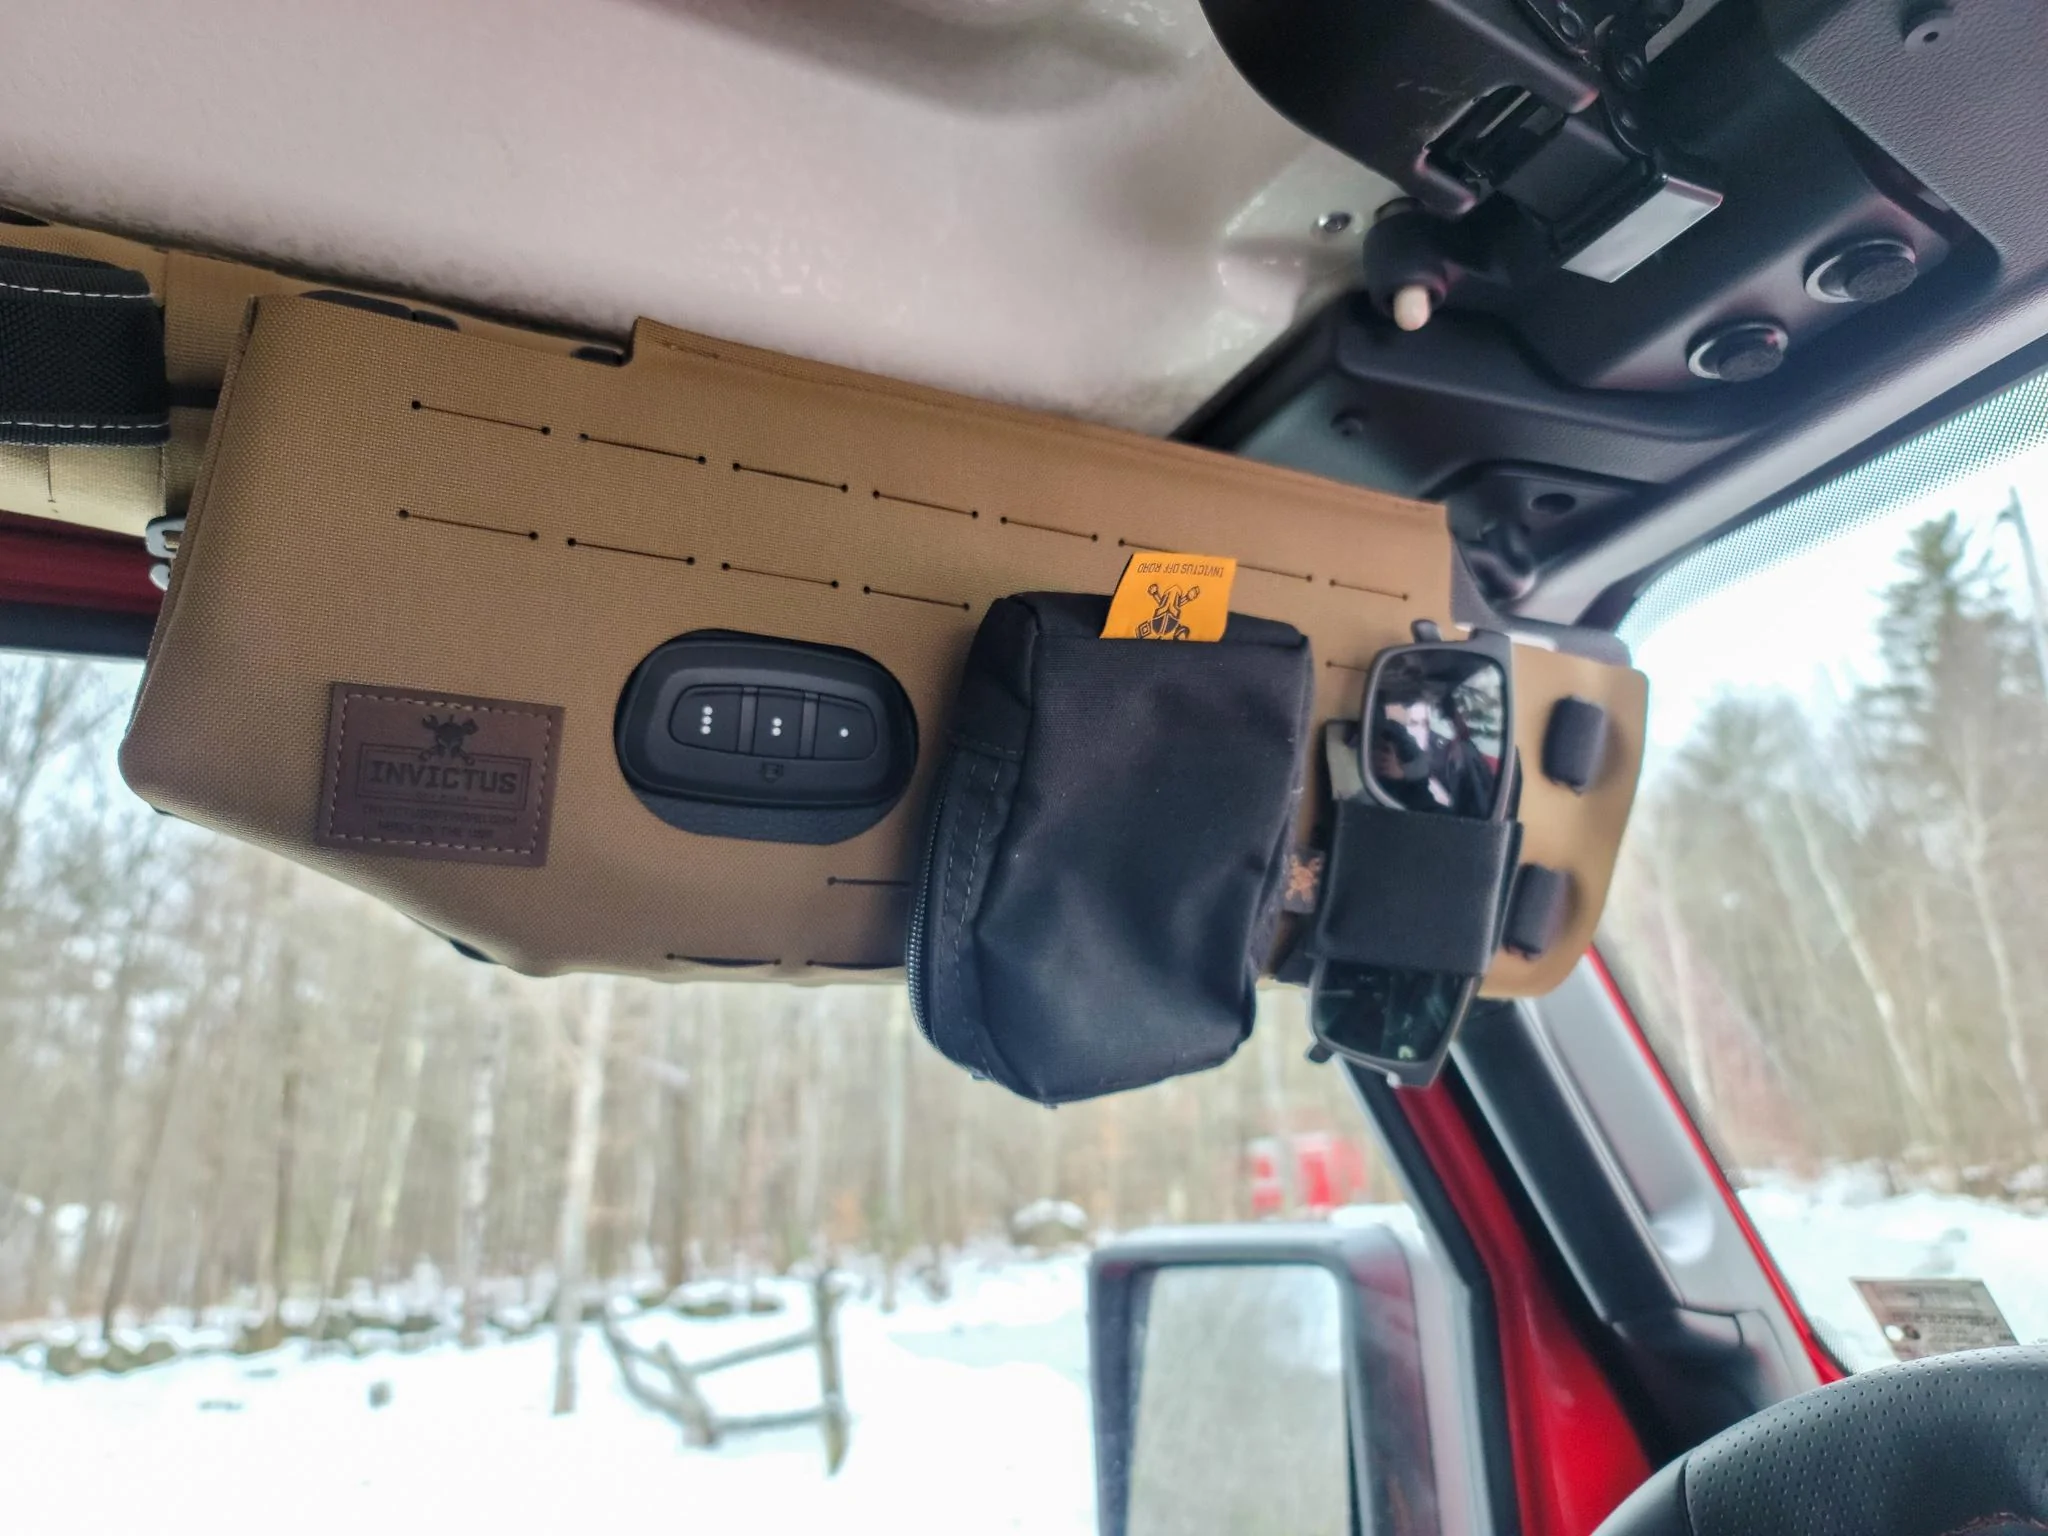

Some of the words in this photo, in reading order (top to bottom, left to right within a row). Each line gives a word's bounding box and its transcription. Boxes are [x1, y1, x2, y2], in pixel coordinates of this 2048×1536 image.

[1137, 562, 1162, 574] ROAD
[1163, 563, 1180, 575] OFF
[1181, 563, 1224, 577] INVICTUS
[369, 760, 518, 795] INVICTUS
